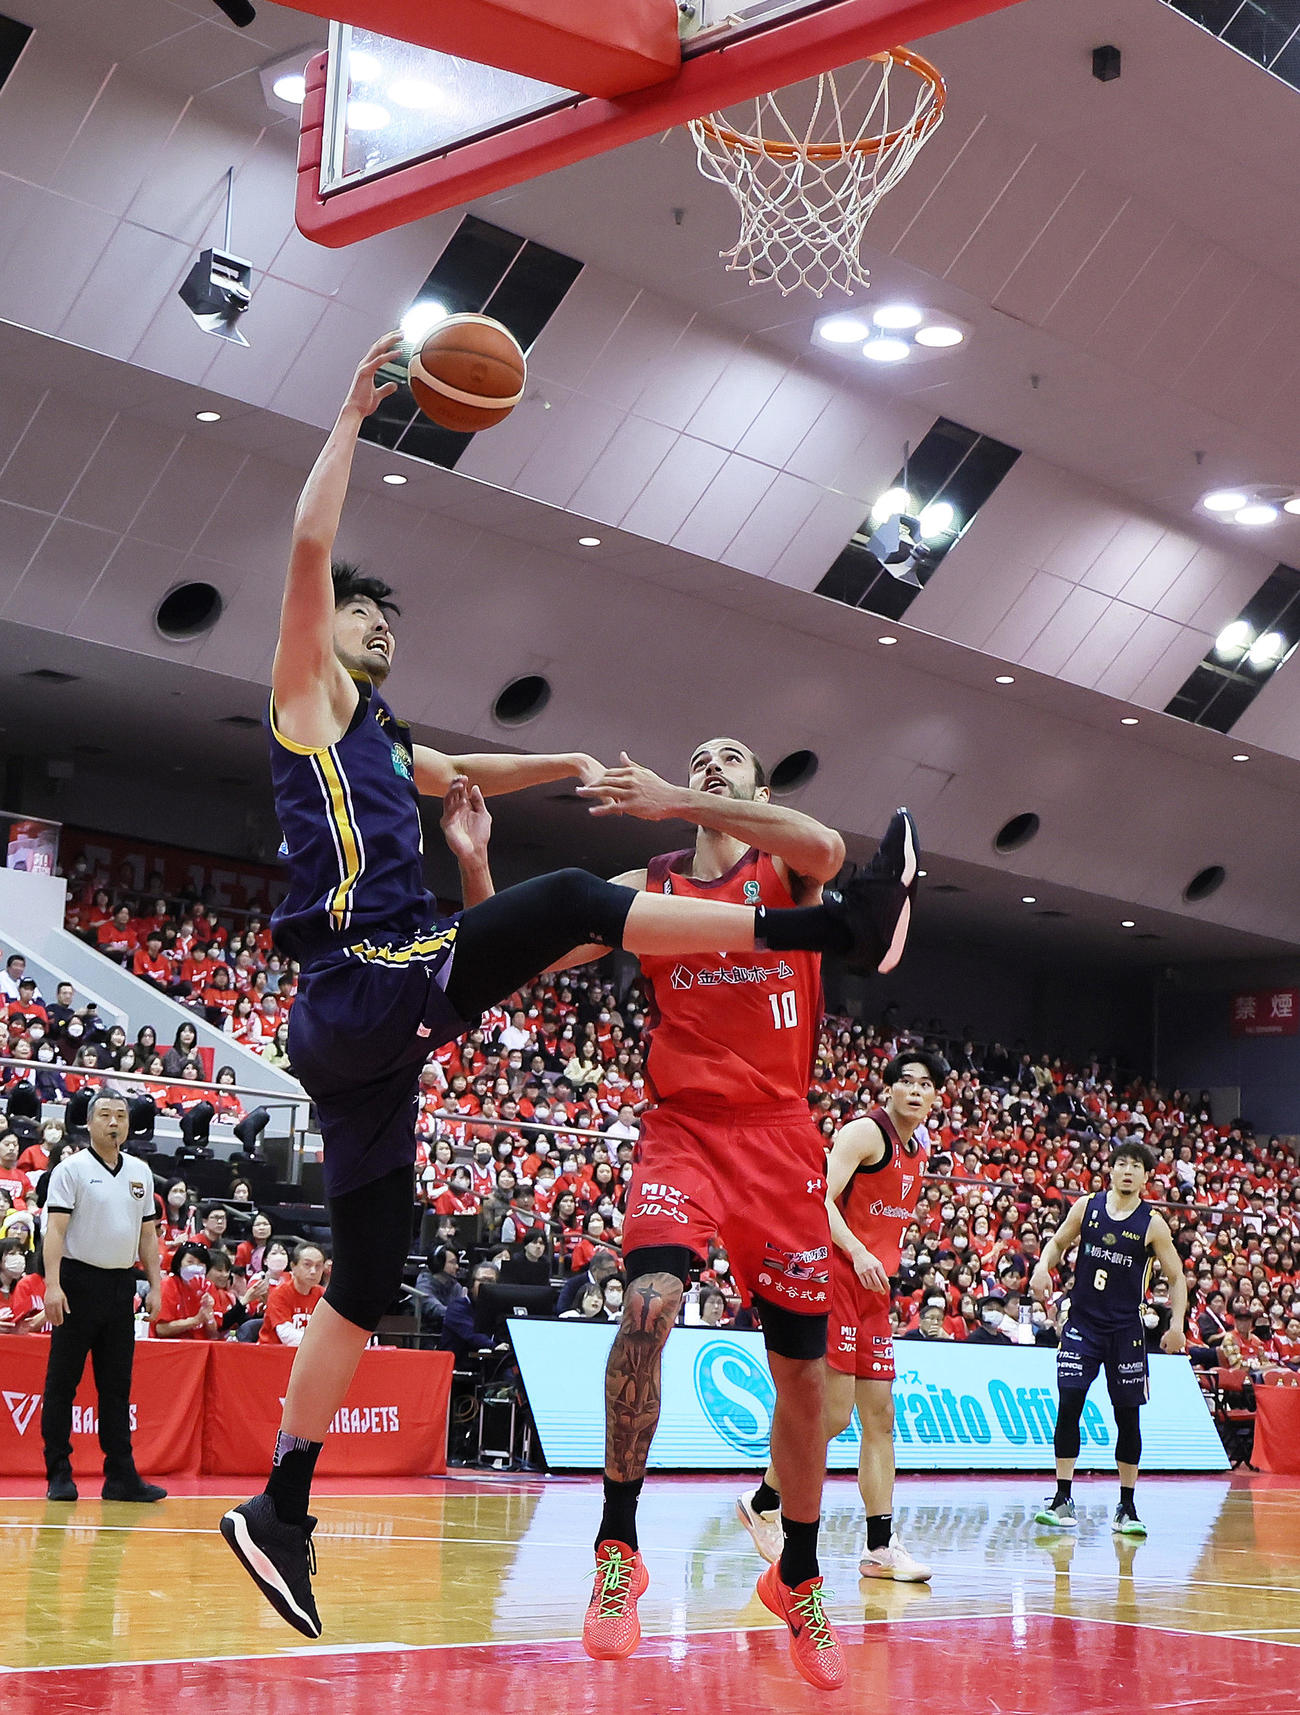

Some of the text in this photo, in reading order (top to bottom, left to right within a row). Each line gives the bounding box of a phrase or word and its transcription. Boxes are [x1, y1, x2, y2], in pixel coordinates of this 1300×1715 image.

[697, 960, 794, 985] 金太郎ホーム
[768, 990, 798, 1030] 10
[1090, 1245, 1133, 1268] 栃木銀行
[774, 1281, 827, 1301] 古谷式典
[1093, 1268, 1108, 1291] 6
[327, 1406, 400, 1434] IBAJETS
[988, 1379, 1110, 1446] Offie
